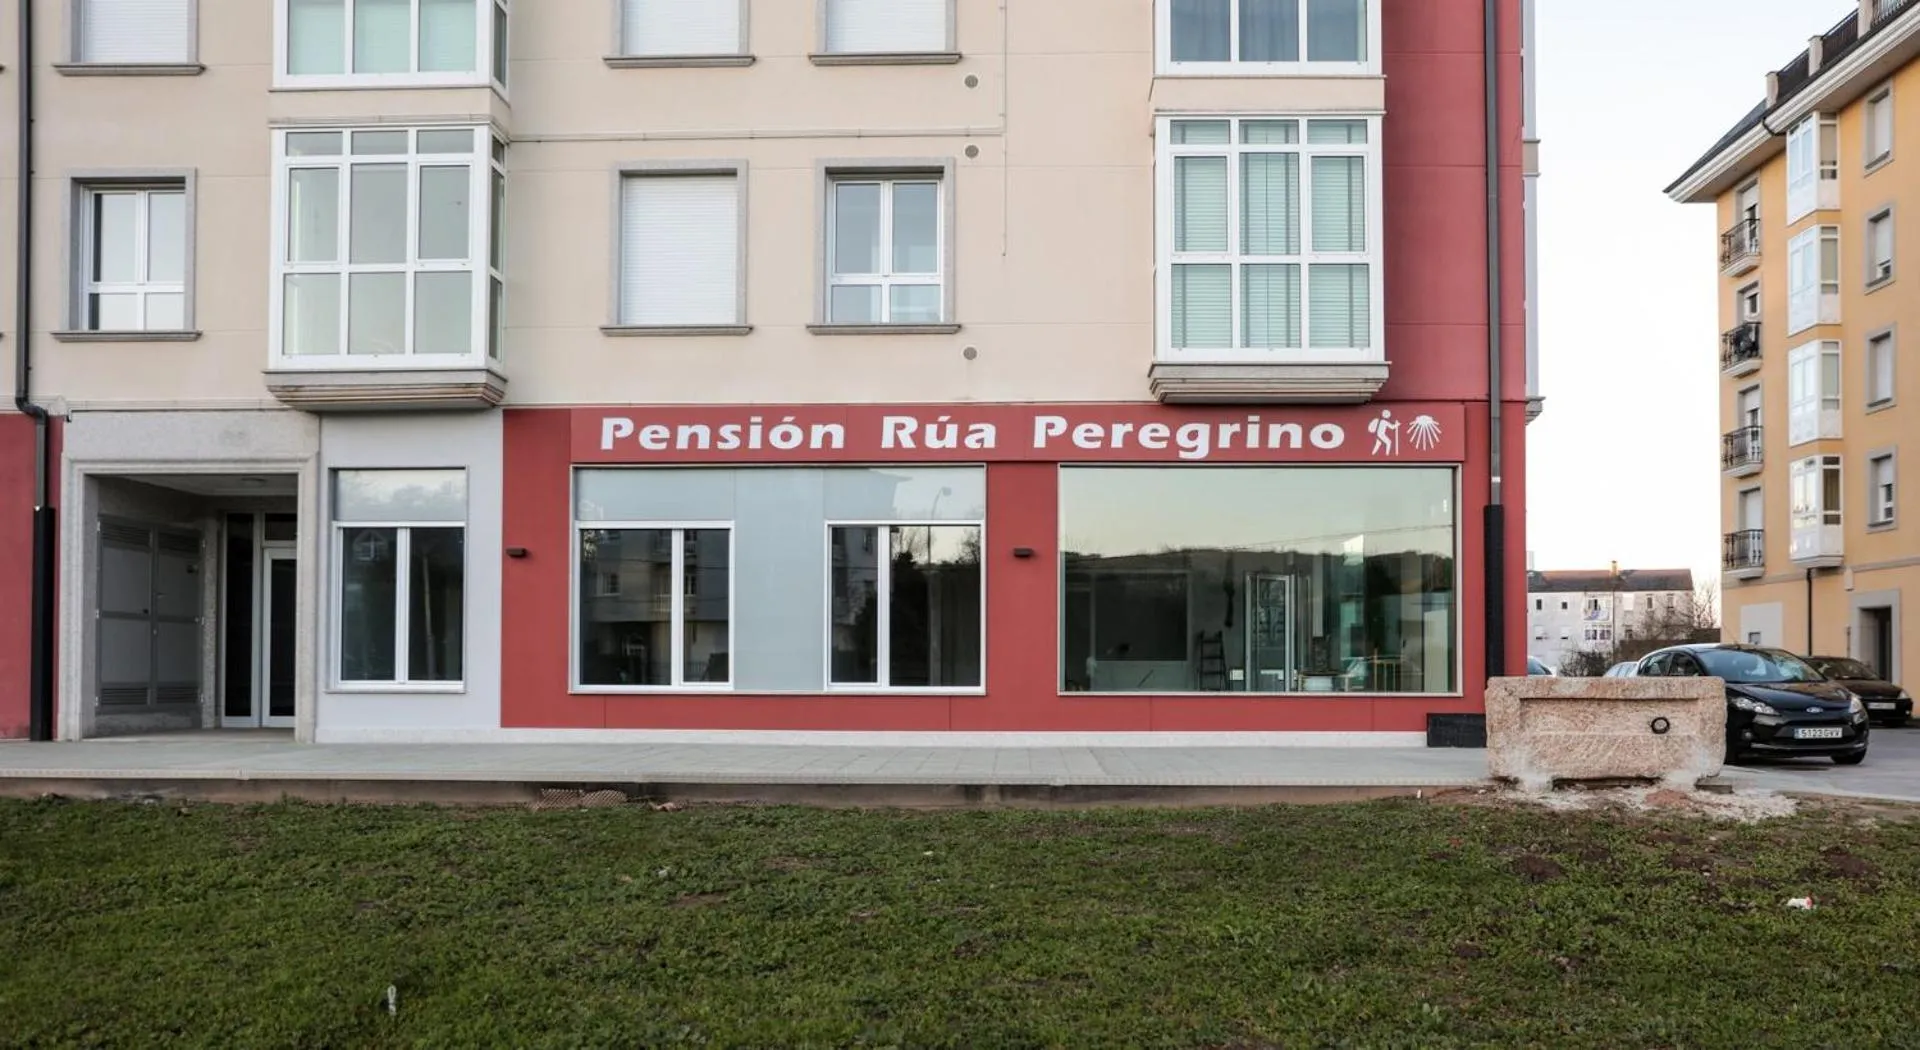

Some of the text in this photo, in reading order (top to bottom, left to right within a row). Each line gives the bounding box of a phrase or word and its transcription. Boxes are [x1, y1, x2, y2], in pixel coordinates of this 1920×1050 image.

[601, 415, 1345, 460] Pensión Rúa Peregrino
